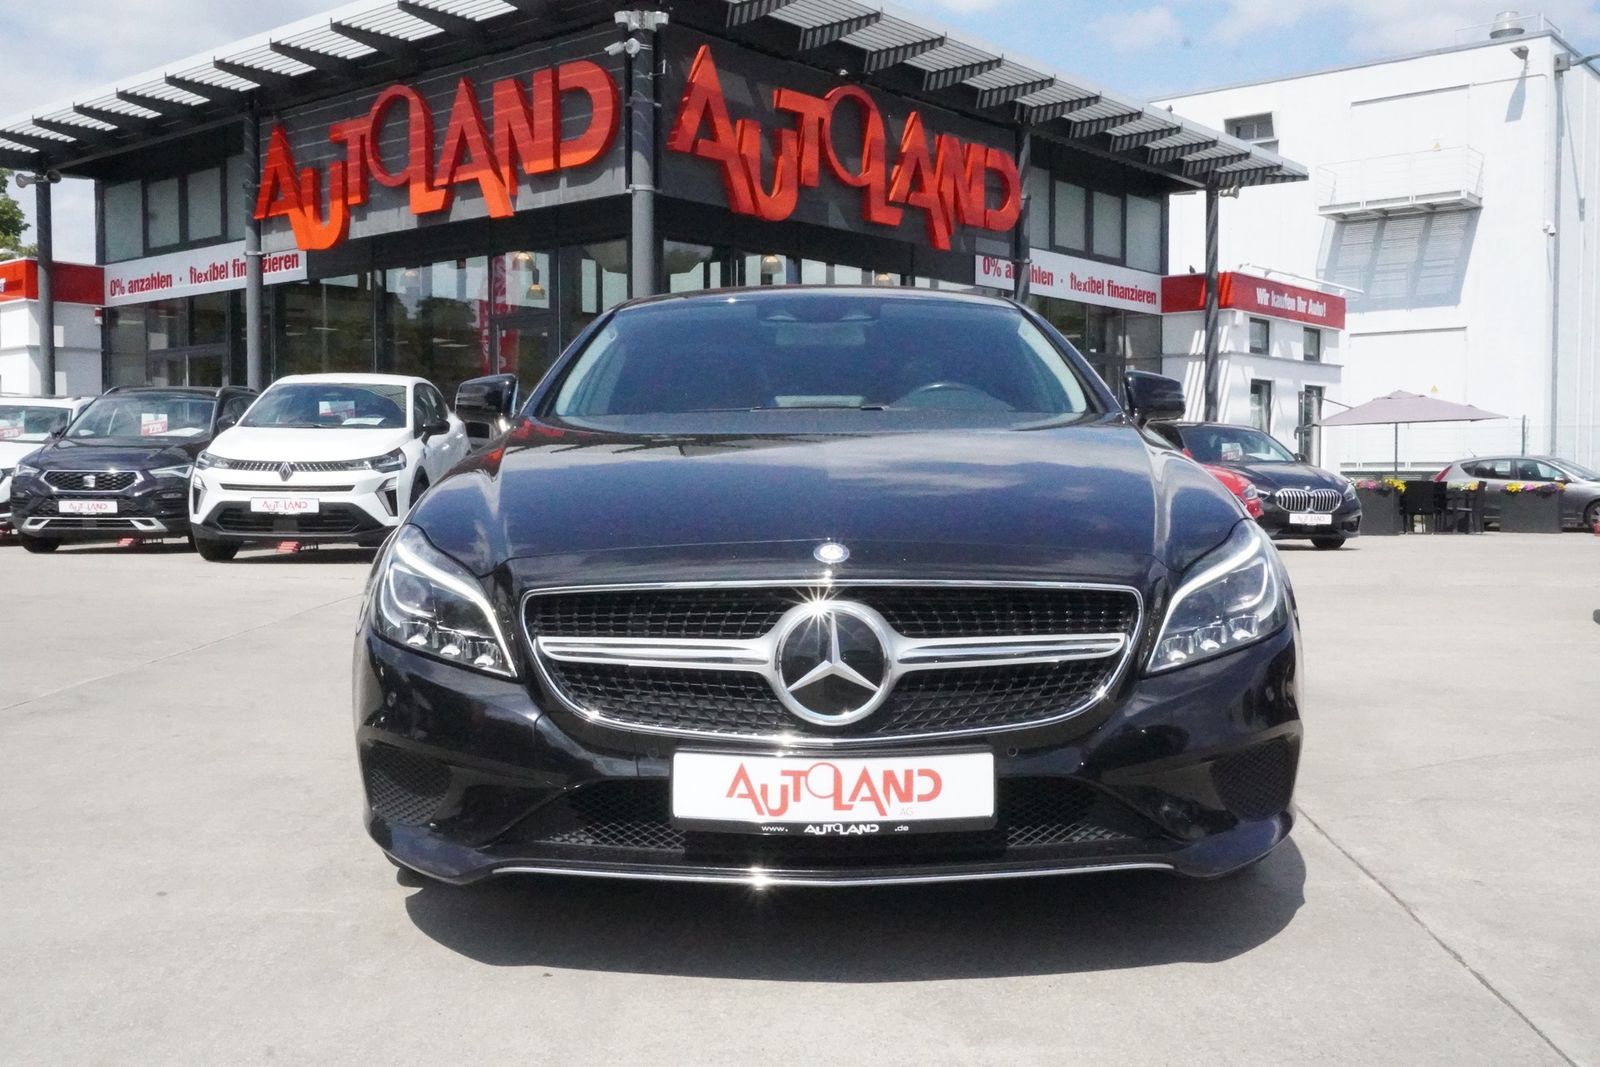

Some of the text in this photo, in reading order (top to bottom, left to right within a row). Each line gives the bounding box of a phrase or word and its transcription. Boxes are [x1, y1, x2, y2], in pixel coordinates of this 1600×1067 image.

[254, 60, 619, 251] AUTOLAND
[667, 44, 1021, 250] AUTOLAND
[110, 253, 299, 297] 0% anzahlen flexibel finzieren
[983, 255, 1157, 305] 0% ahlen flexibel finanzieren
[1256, 287, 1270, 306] Wir
[1271, 289, 1296, 311] kaufen
[1296, 295, 1308, 314] Ihr
[69, 502, 108, 513] AUTLAND
[262, 500, 309, 512] AUTLAND
[726, 761, 943, 817] AUTOLAND
[761, 822, 909, 836] www. AUTOLAND .de
[899, 806, 914, 817] AG
